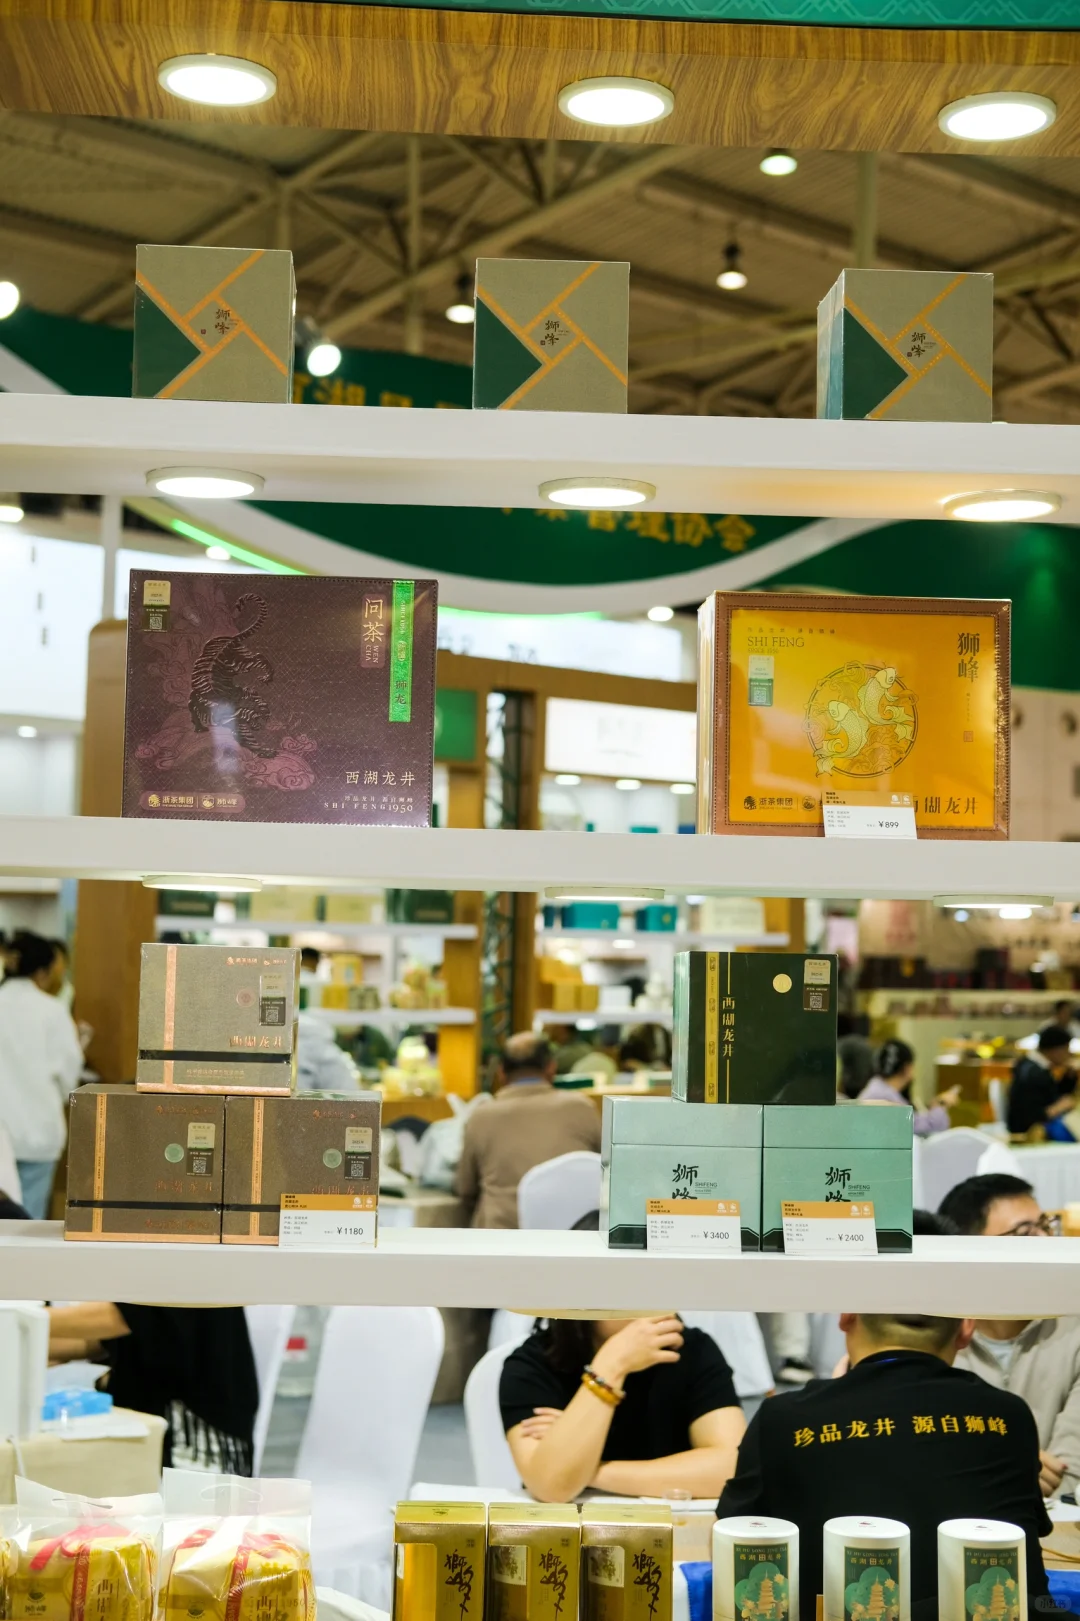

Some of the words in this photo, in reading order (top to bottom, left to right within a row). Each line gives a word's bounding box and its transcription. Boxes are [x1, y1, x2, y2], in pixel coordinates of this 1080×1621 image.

[362, 598, 385, 642] 问茶
[747, 636, 768, 647] SHI
[772, 636, 805, 648] FENG
[957, 632, 980, 682] 狮峰
[345, 770, 415, 787] 西湖龙井
[388, 804, 413, 814] 1950
[758, 797, 793, 806] 浙茶集团
[722, 996, 735, 1058] 西湖龙井
[793, 1417, 897, 1448] 珍品龙井
[911, 1414, 1009, 1437] 源自狮峰
